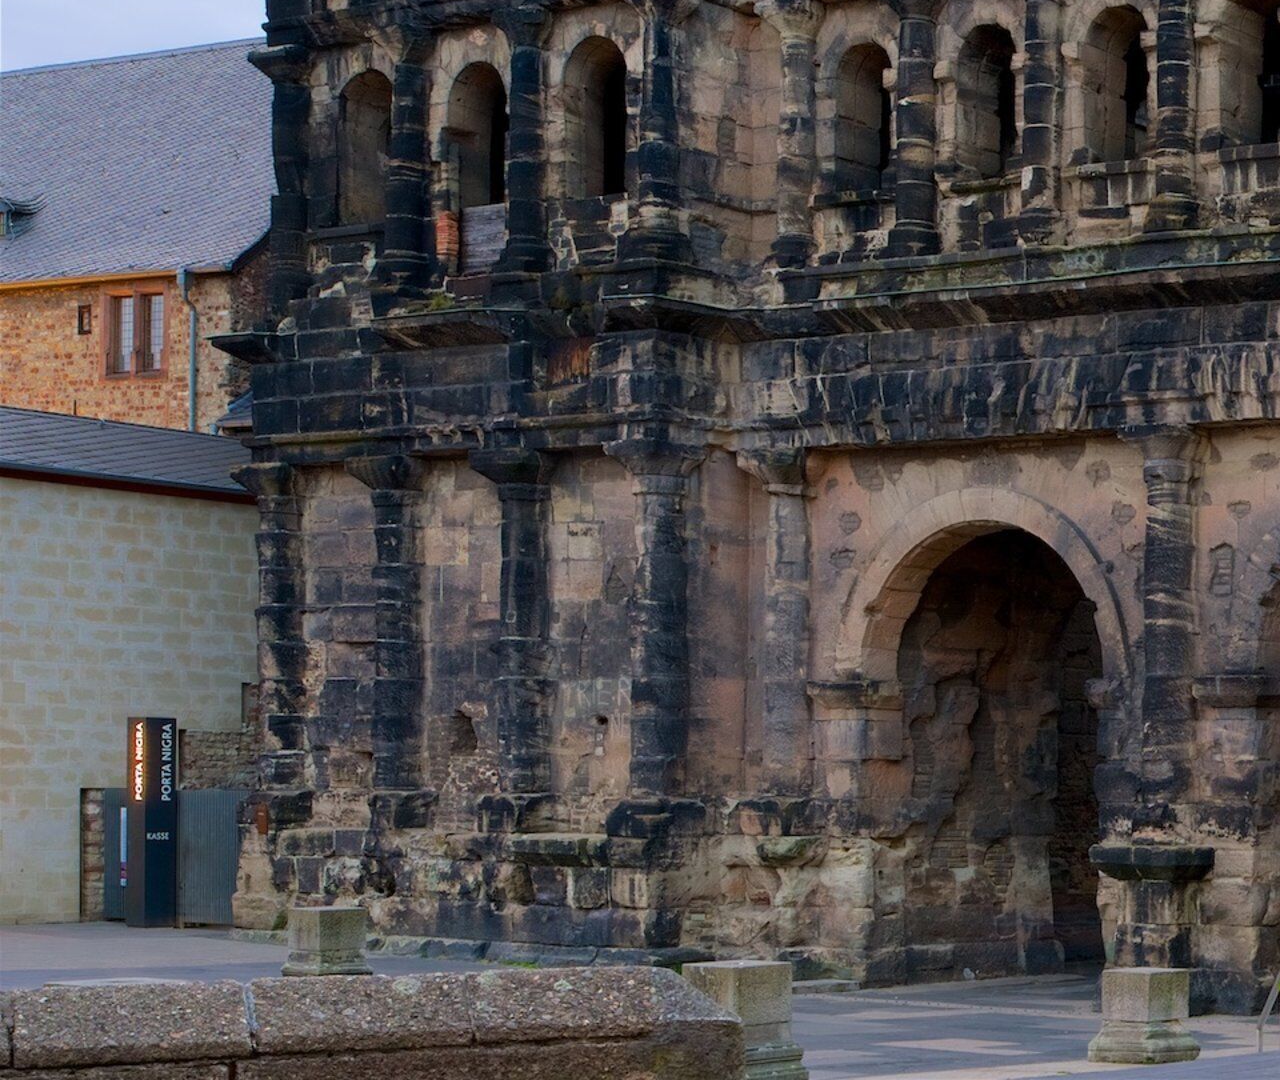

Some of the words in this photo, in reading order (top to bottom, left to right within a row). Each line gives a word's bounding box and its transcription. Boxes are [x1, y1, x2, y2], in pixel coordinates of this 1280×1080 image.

[135, 722, 144, 760] NIGRA
[161, 723, 172, 762] NIGRA
[135, 763, 144, 801] PORTA
[161, 764, 172, 801] PORTA
[146, 832, 169, 840] KASSE
